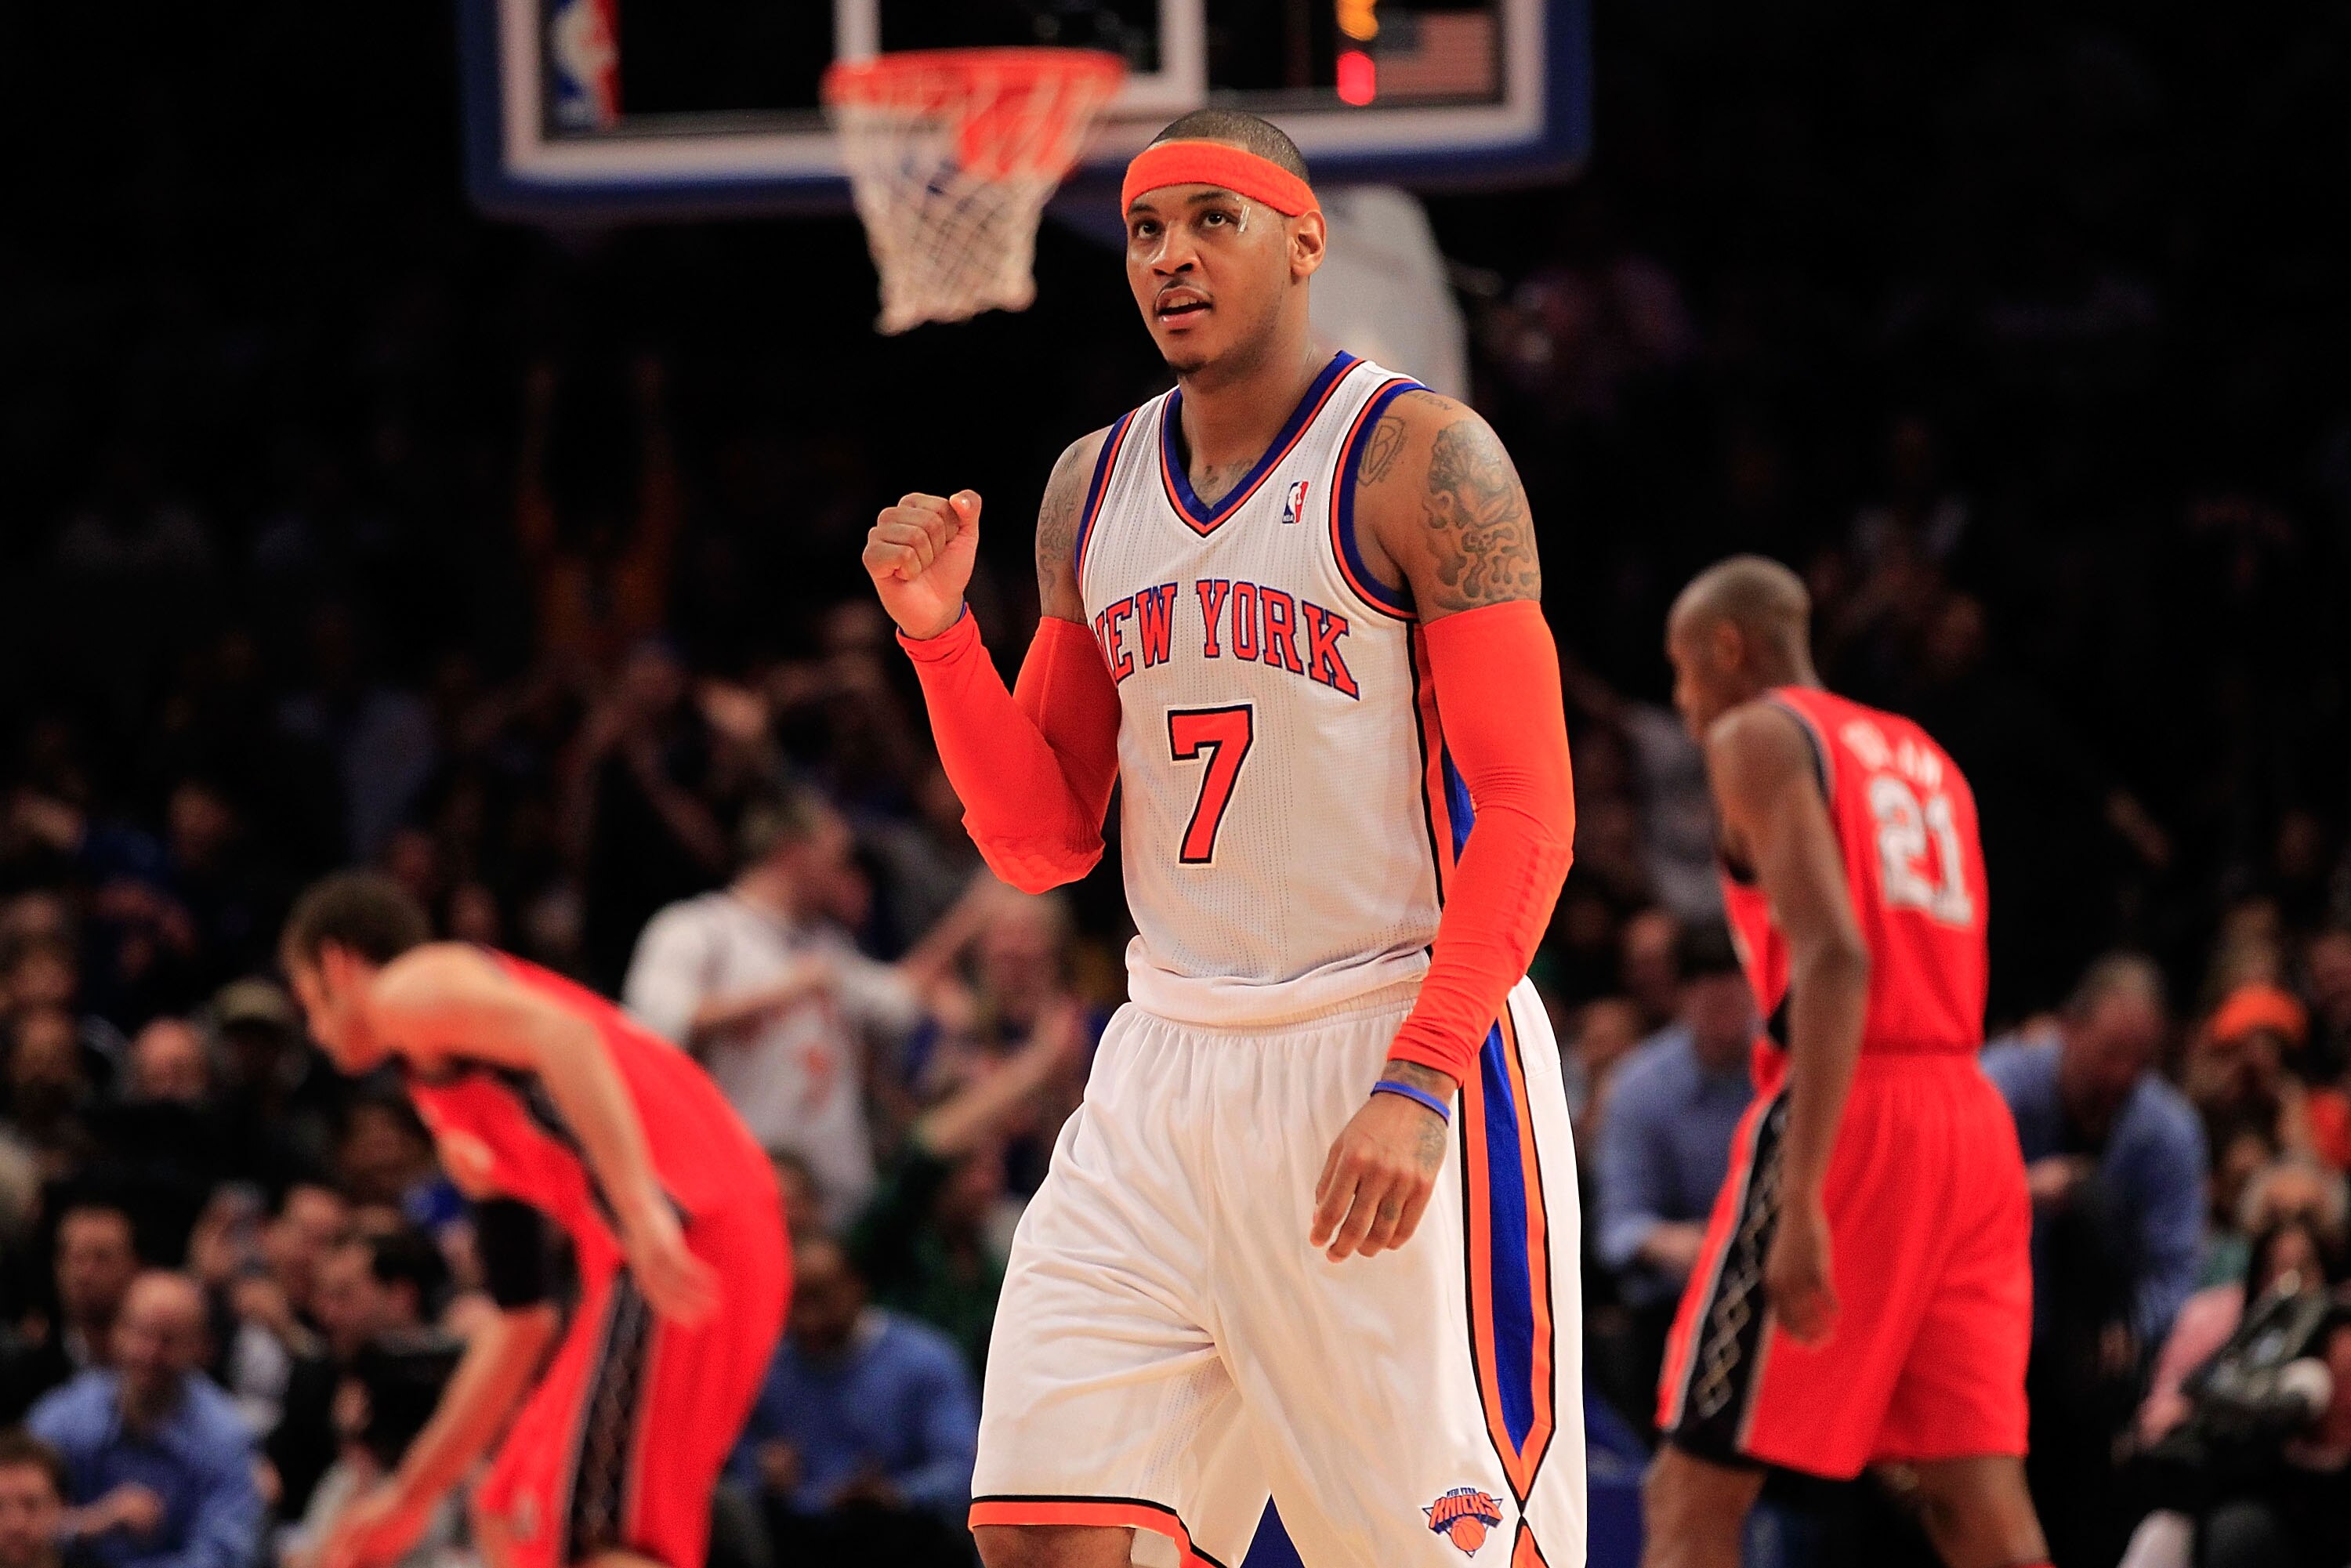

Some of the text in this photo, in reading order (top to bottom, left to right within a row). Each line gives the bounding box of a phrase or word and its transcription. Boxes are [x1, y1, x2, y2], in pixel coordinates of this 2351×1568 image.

[1196, 579, 1360, 701] YORK
[1168, 704, 1254, 864] 7
[1870, 775, 1973, 927] 21
[1428, 1492, 1503, 1531] KNICKS
